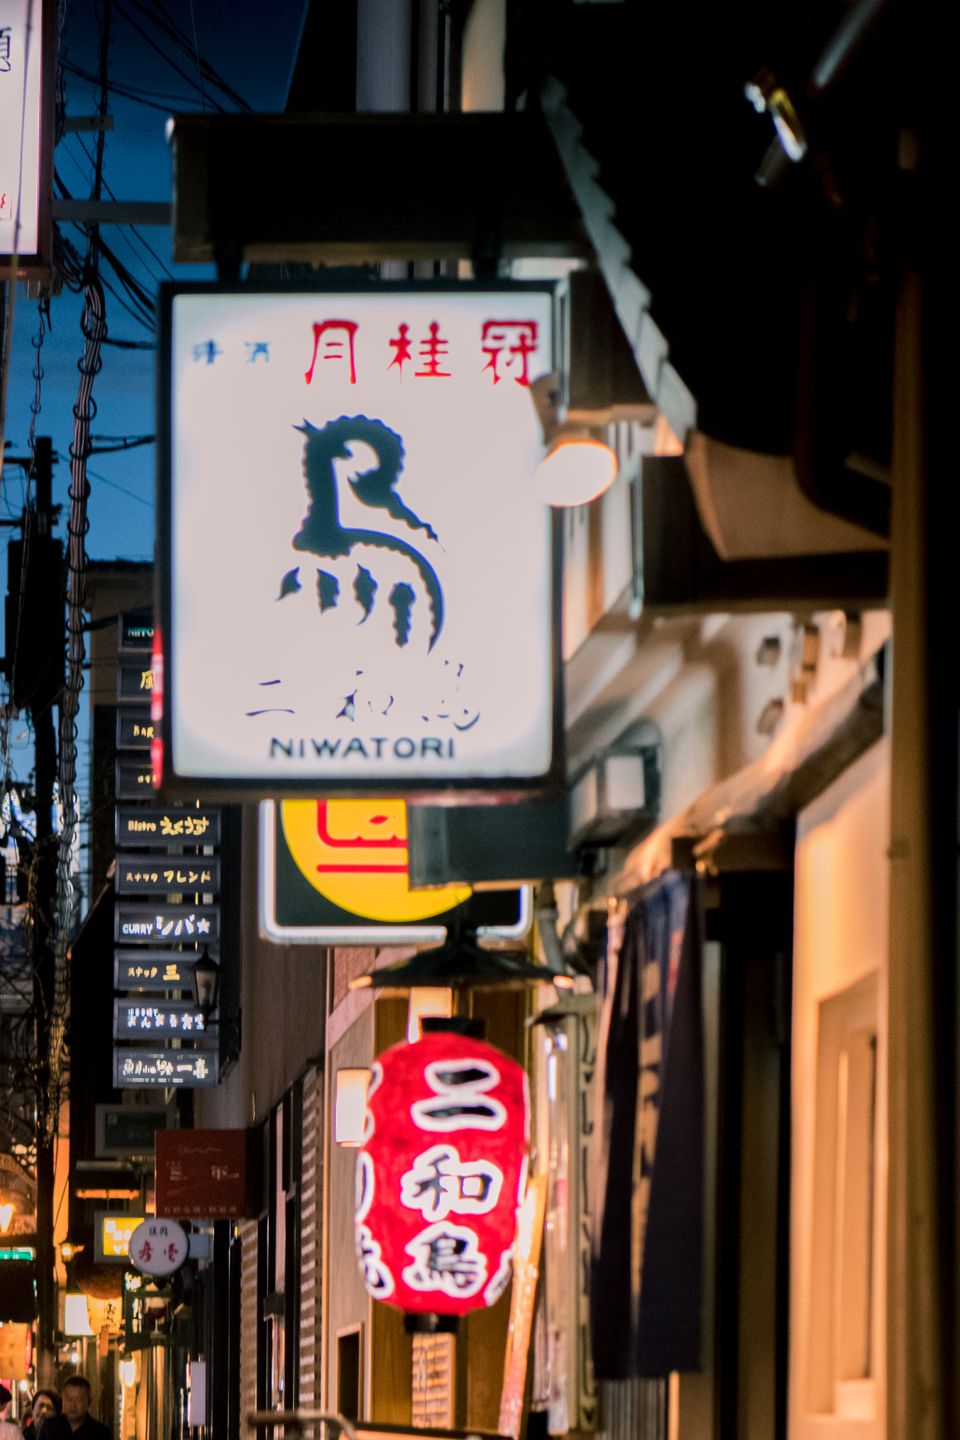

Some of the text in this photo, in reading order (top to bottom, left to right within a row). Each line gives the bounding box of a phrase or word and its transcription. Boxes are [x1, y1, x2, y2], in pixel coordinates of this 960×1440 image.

[305, 319, 539, 387] 月桂冠
[269, 737, 455, 759] NIWATORI
[127, 820, 157, 832] Bistro
[163, 870, 211, 884] フレンド
[122, 923, 153, 935] CURRY
[402, 1060, 506, 1297] 二和鳥
